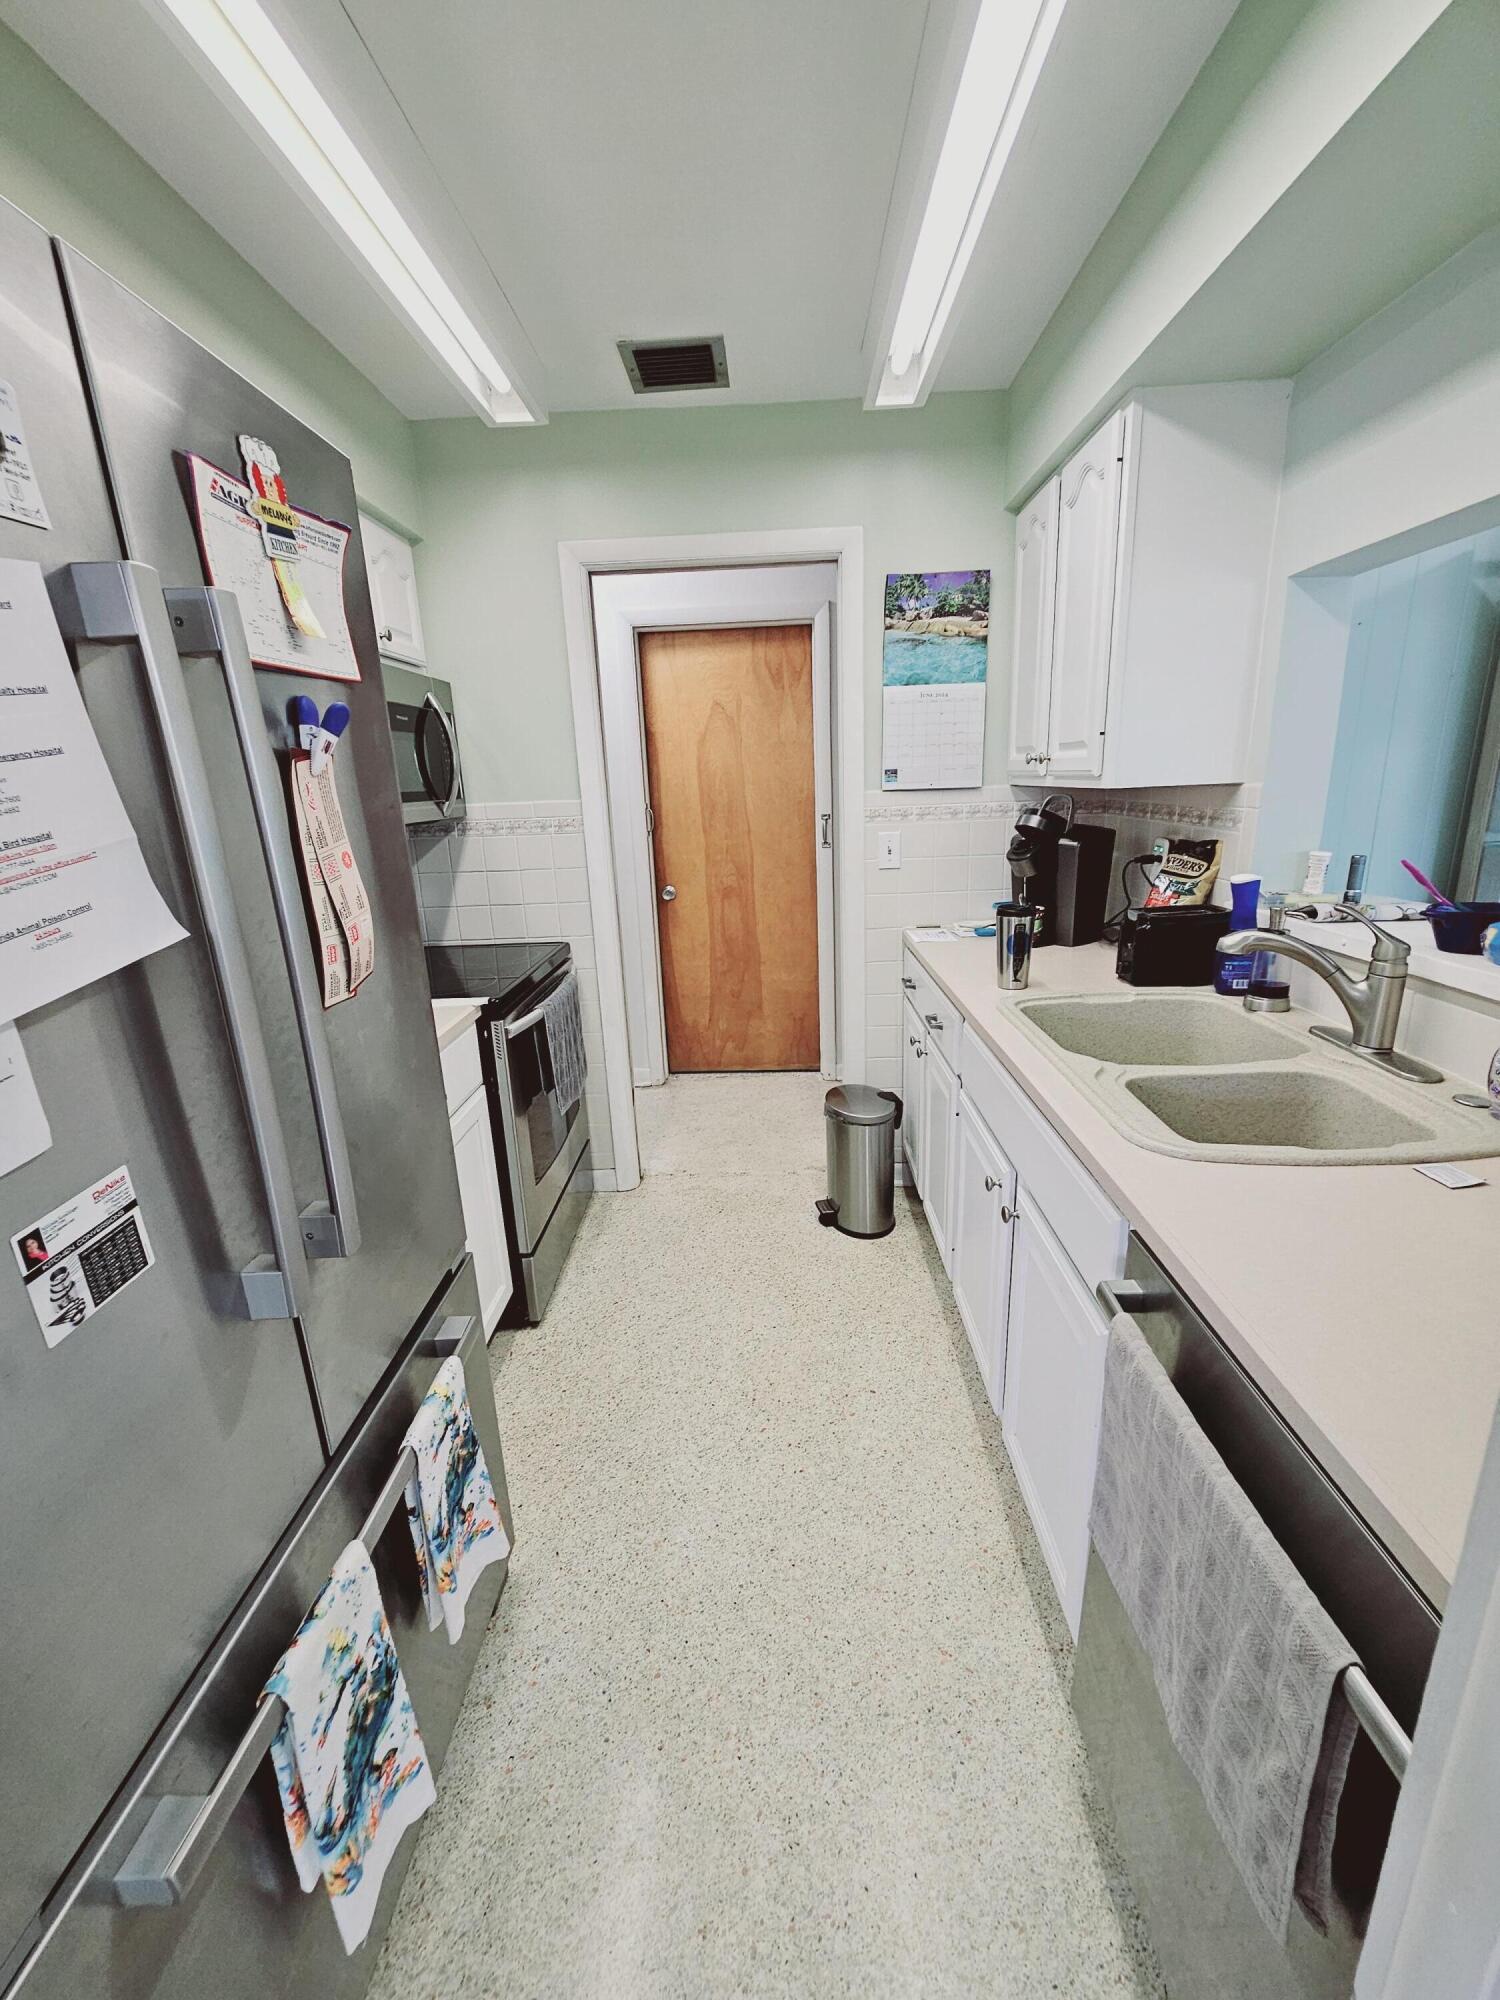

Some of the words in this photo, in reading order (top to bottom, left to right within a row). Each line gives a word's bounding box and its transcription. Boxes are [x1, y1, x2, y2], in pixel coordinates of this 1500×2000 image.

[33, 746, 64, 758] Hospital
[2, 838, 20, 850] Bird
[21, 831, 53, 844] Hospital
[1166, 856, 1205, 873] NYDER'S
[16, 920, 41, 935] Animal
[42, 913, 67, 925] Poison
[67, 902, 92, 917] Control
[42, 1245, 76, 1271] KITCHEN
[76, 1209, 125, 1246] CONVERSIONS
